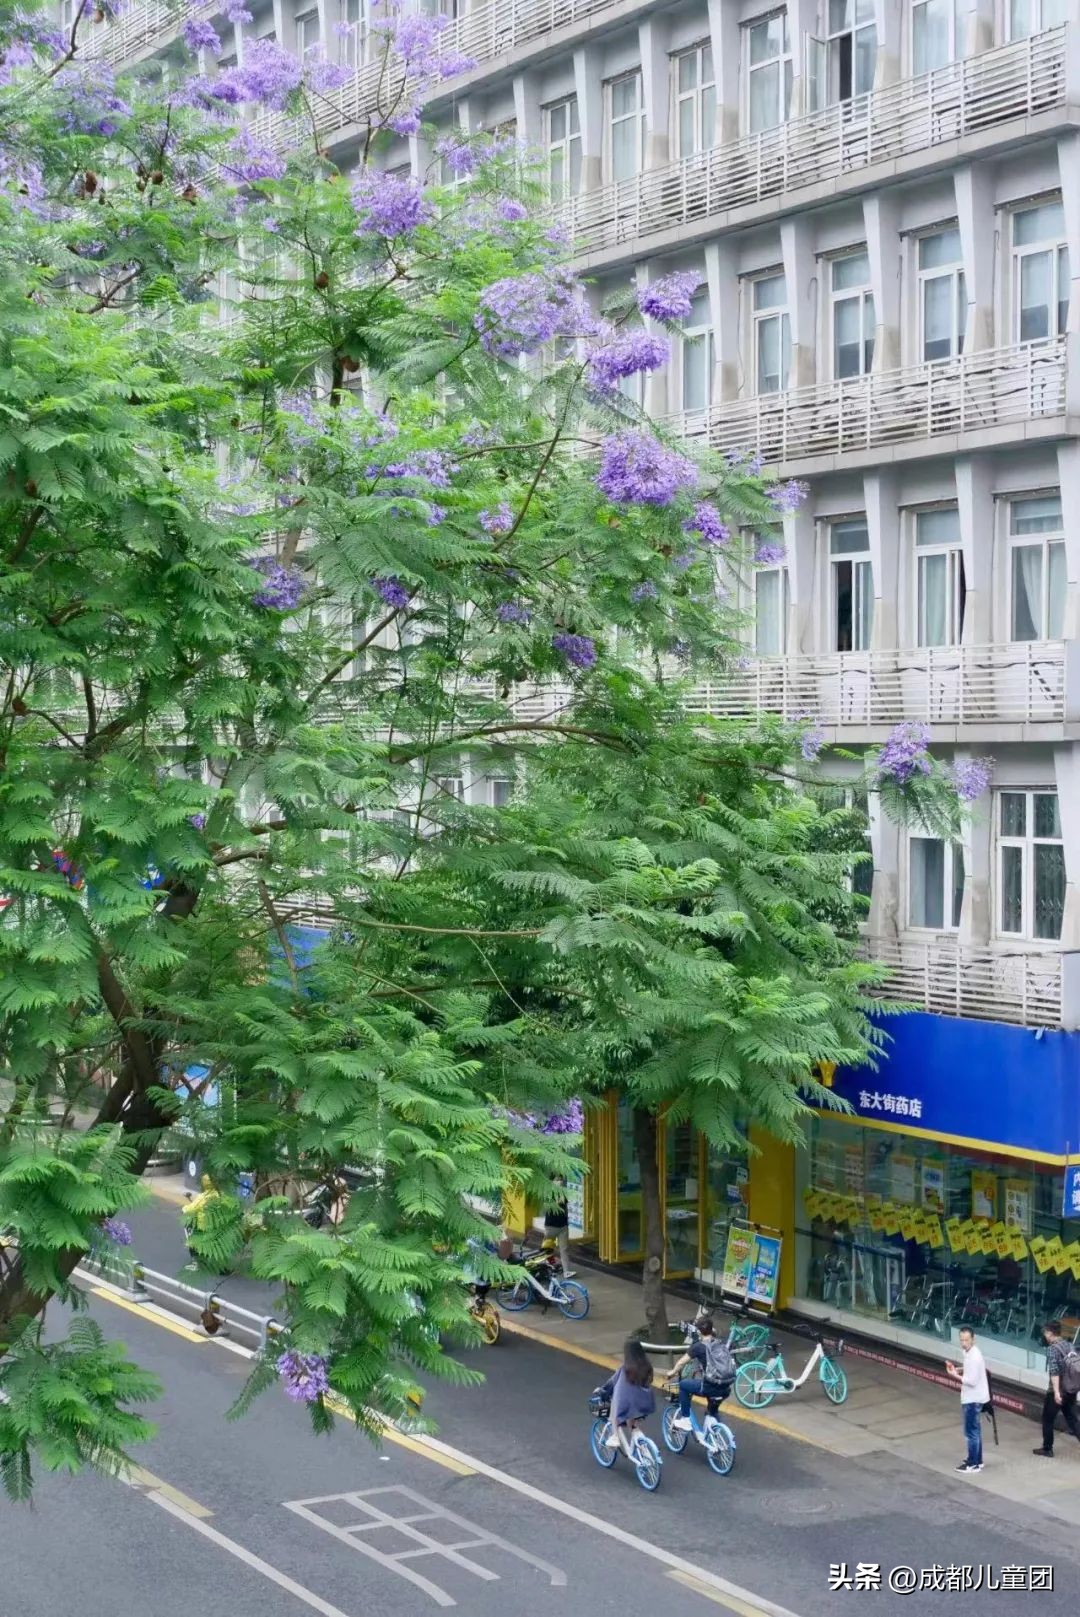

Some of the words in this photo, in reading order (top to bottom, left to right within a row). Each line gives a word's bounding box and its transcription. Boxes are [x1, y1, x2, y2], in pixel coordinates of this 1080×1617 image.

[859, 1090, 922, 1118] 东大街药店
[282, 1484, 568, 1607] 用
